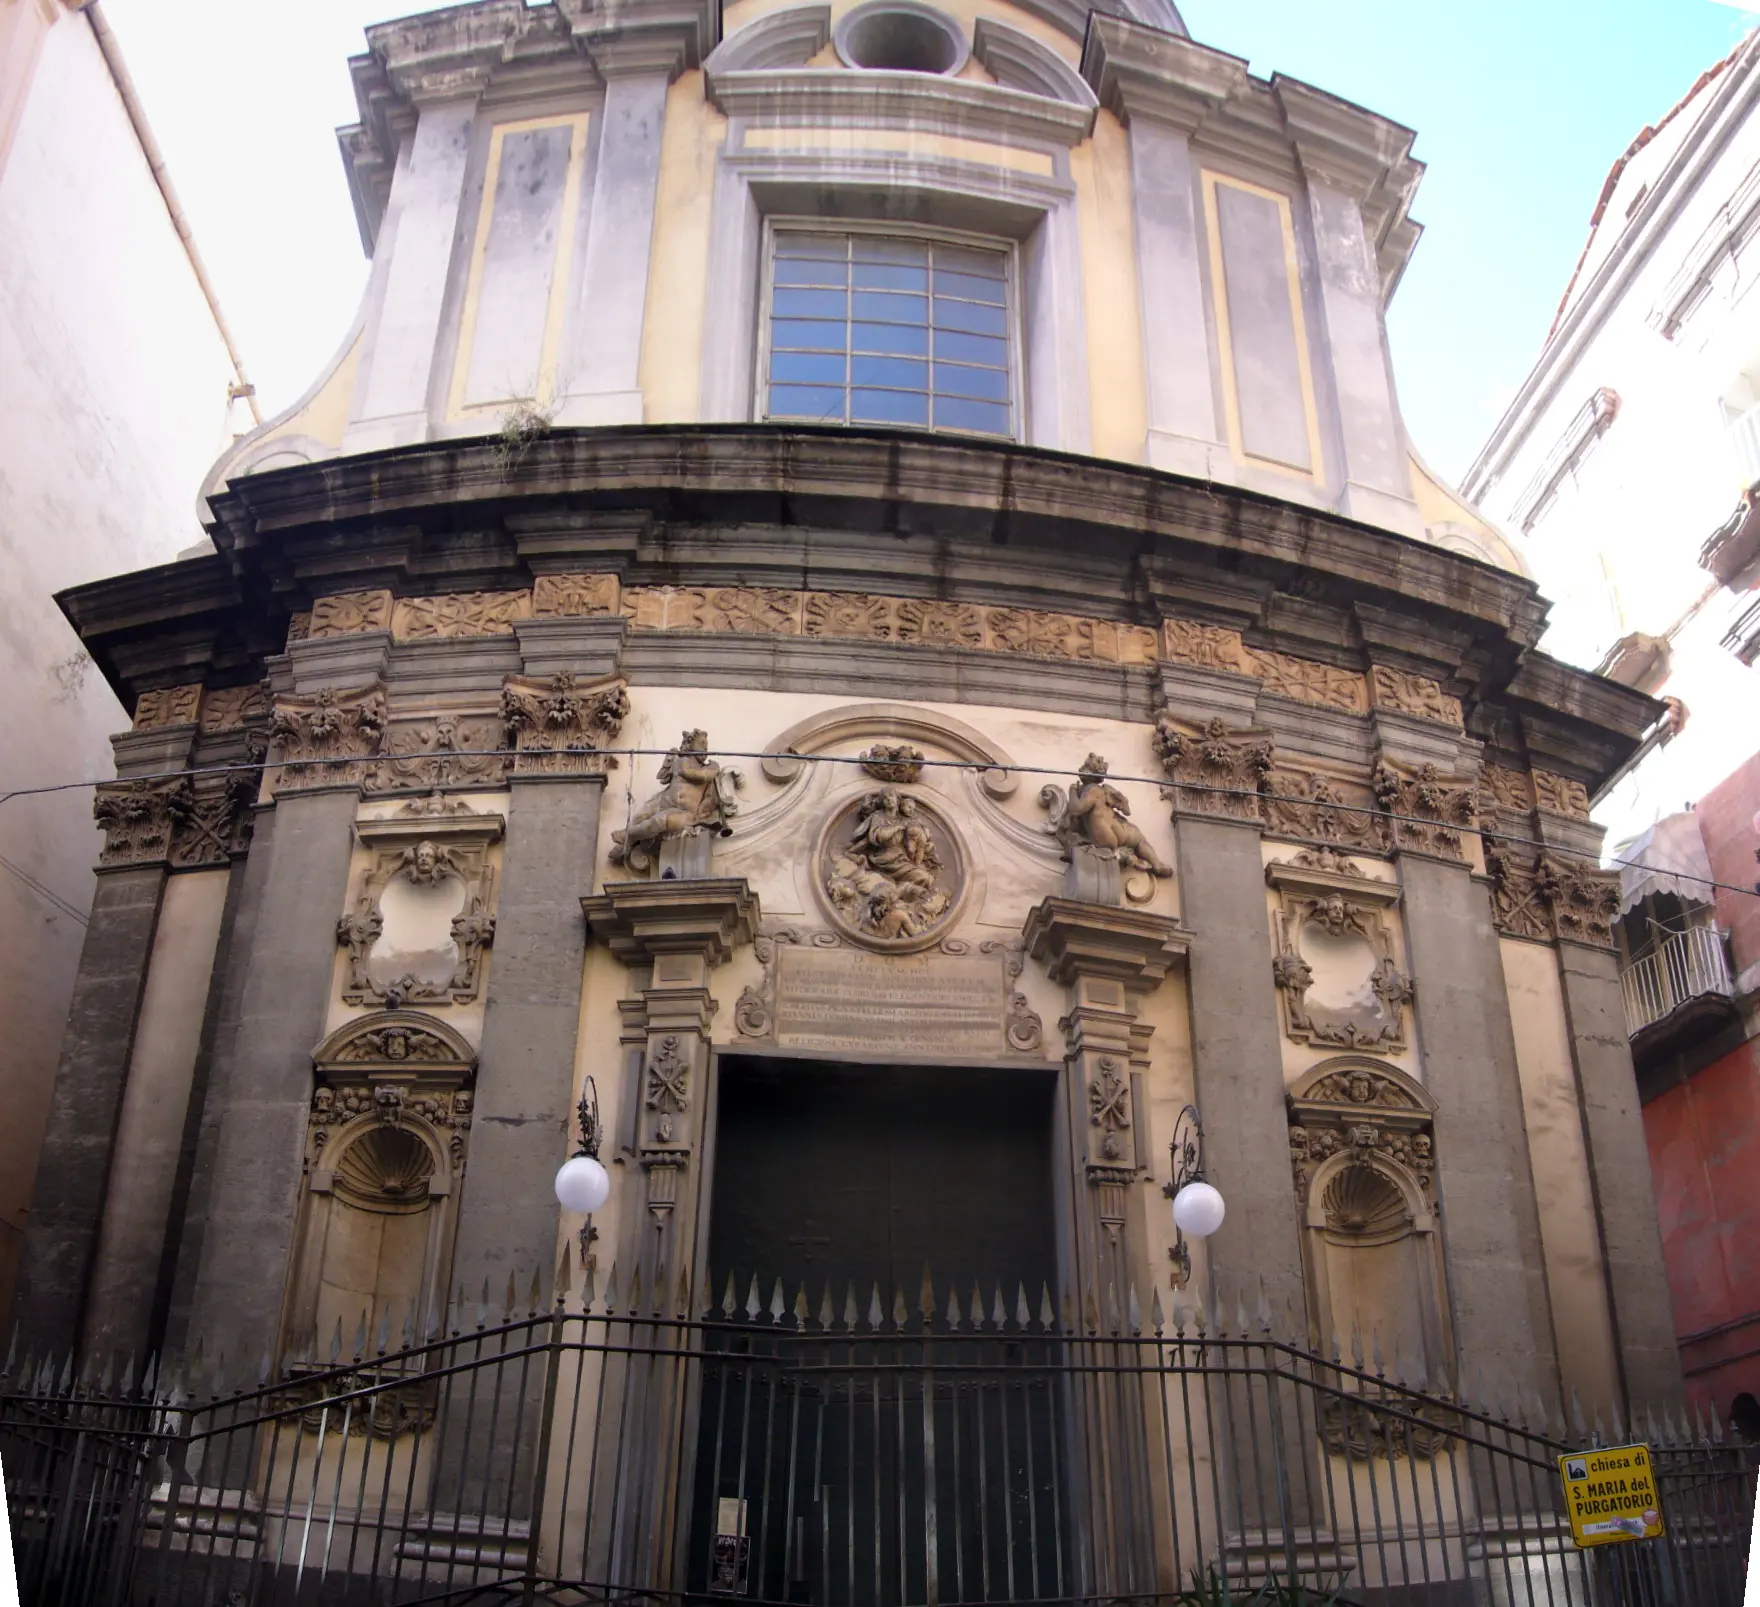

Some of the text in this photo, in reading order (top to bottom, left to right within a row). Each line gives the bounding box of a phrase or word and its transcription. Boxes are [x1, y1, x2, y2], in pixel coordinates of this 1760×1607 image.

[1590, 1451, 1646, 1473] chiesa di
[1572, 1475, 1651, 1500] S. MARIA del
[1575, 1492, 1654, 1517] PURGATORIO
